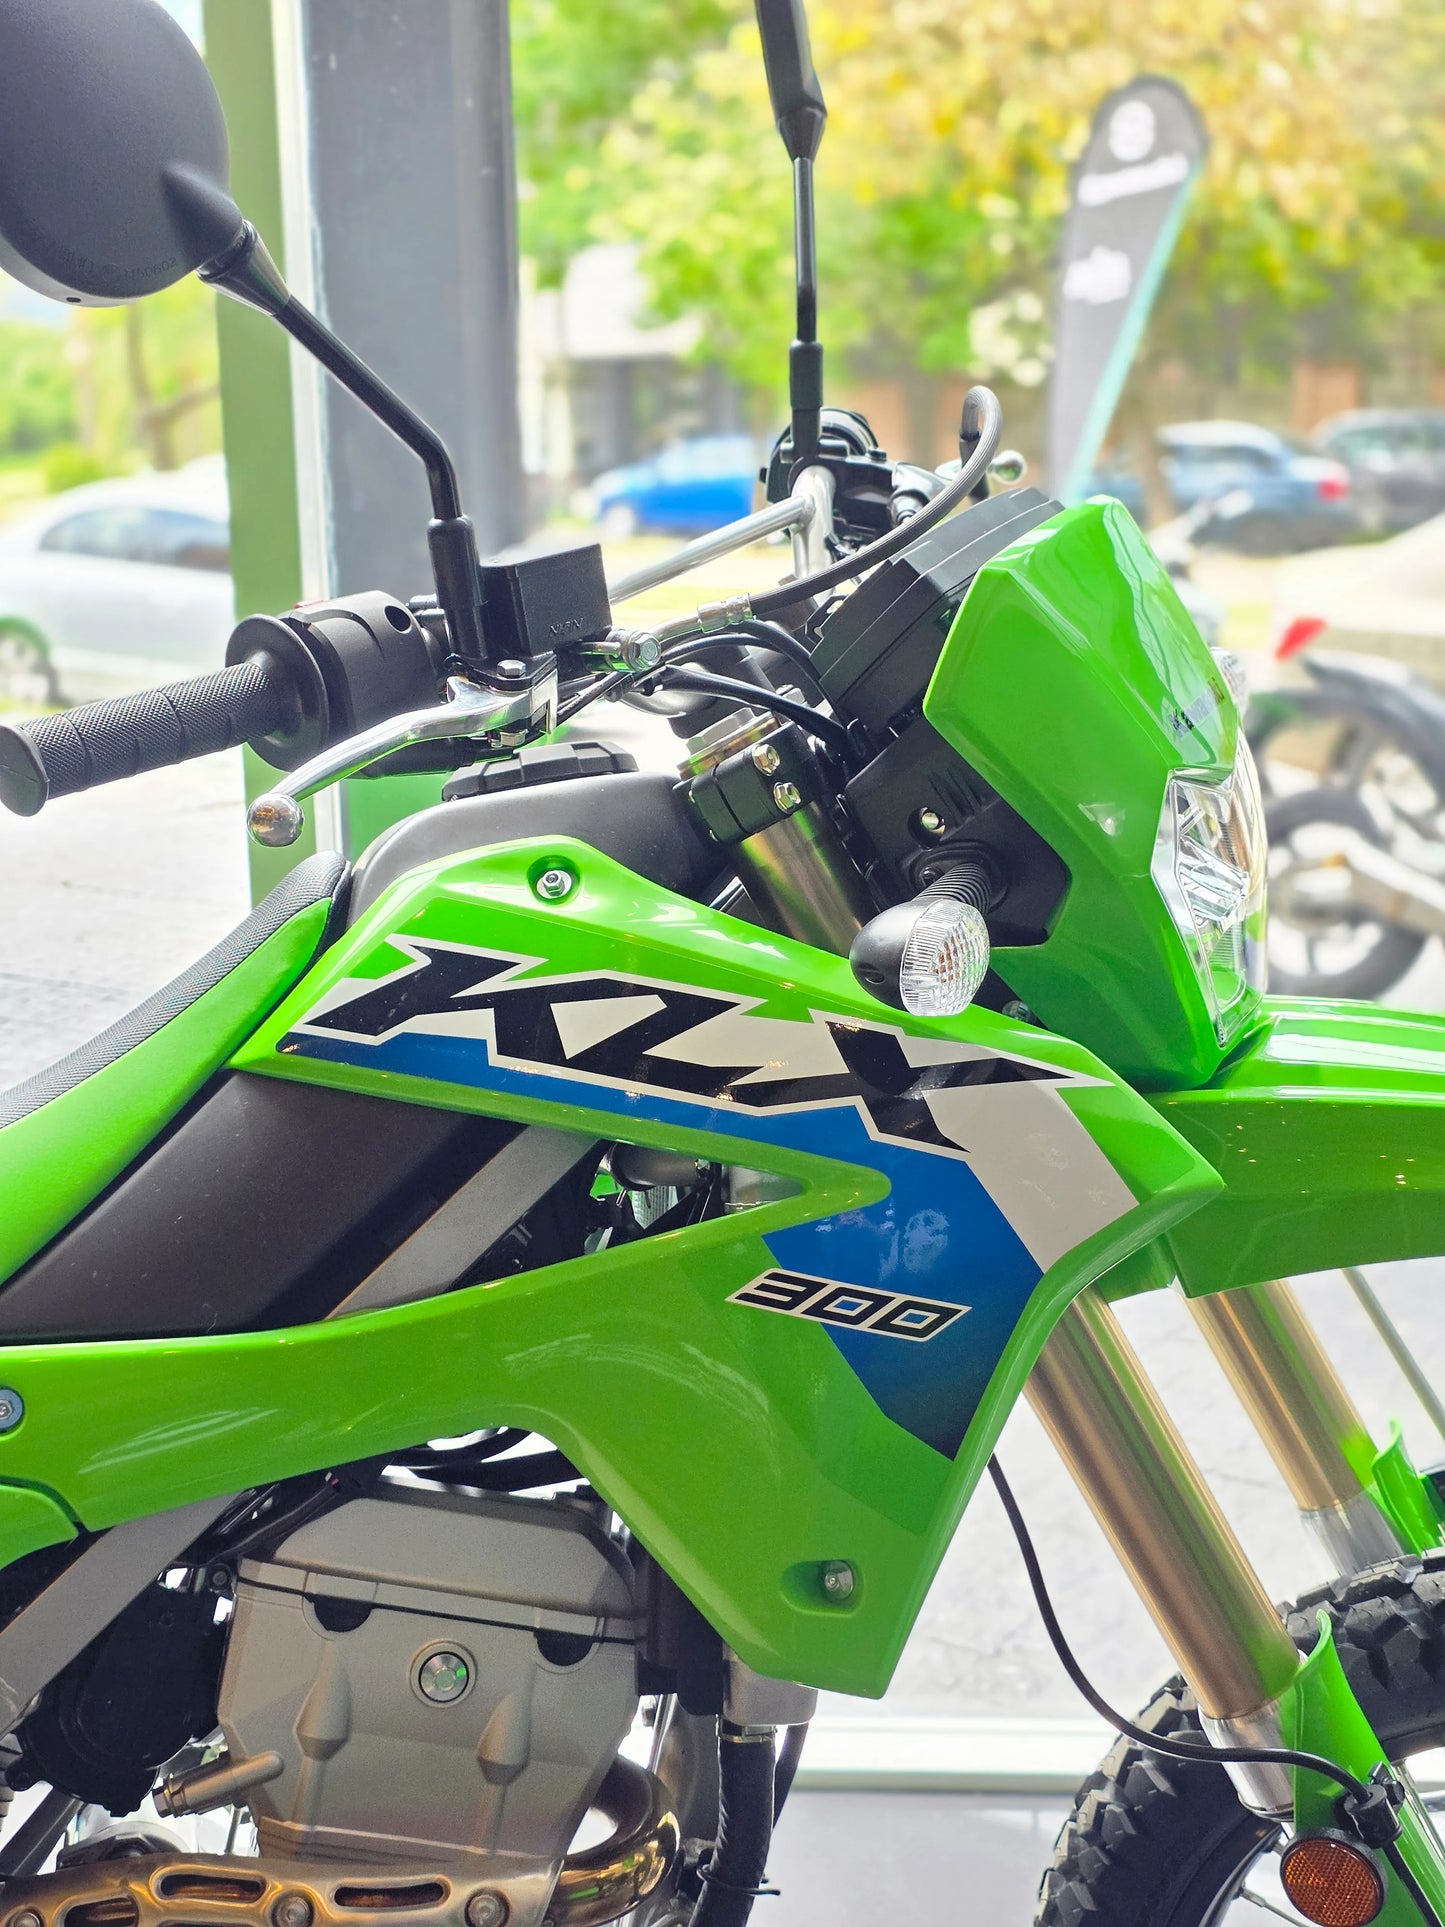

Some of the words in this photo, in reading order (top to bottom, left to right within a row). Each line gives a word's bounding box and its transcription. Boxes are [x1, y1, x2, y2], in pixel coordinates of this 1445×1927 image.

[1167, 676, 1225, 738] Kaki
[305, 944, 1076, 1153] KLX
[733, 1271, 964, 1339] 300
